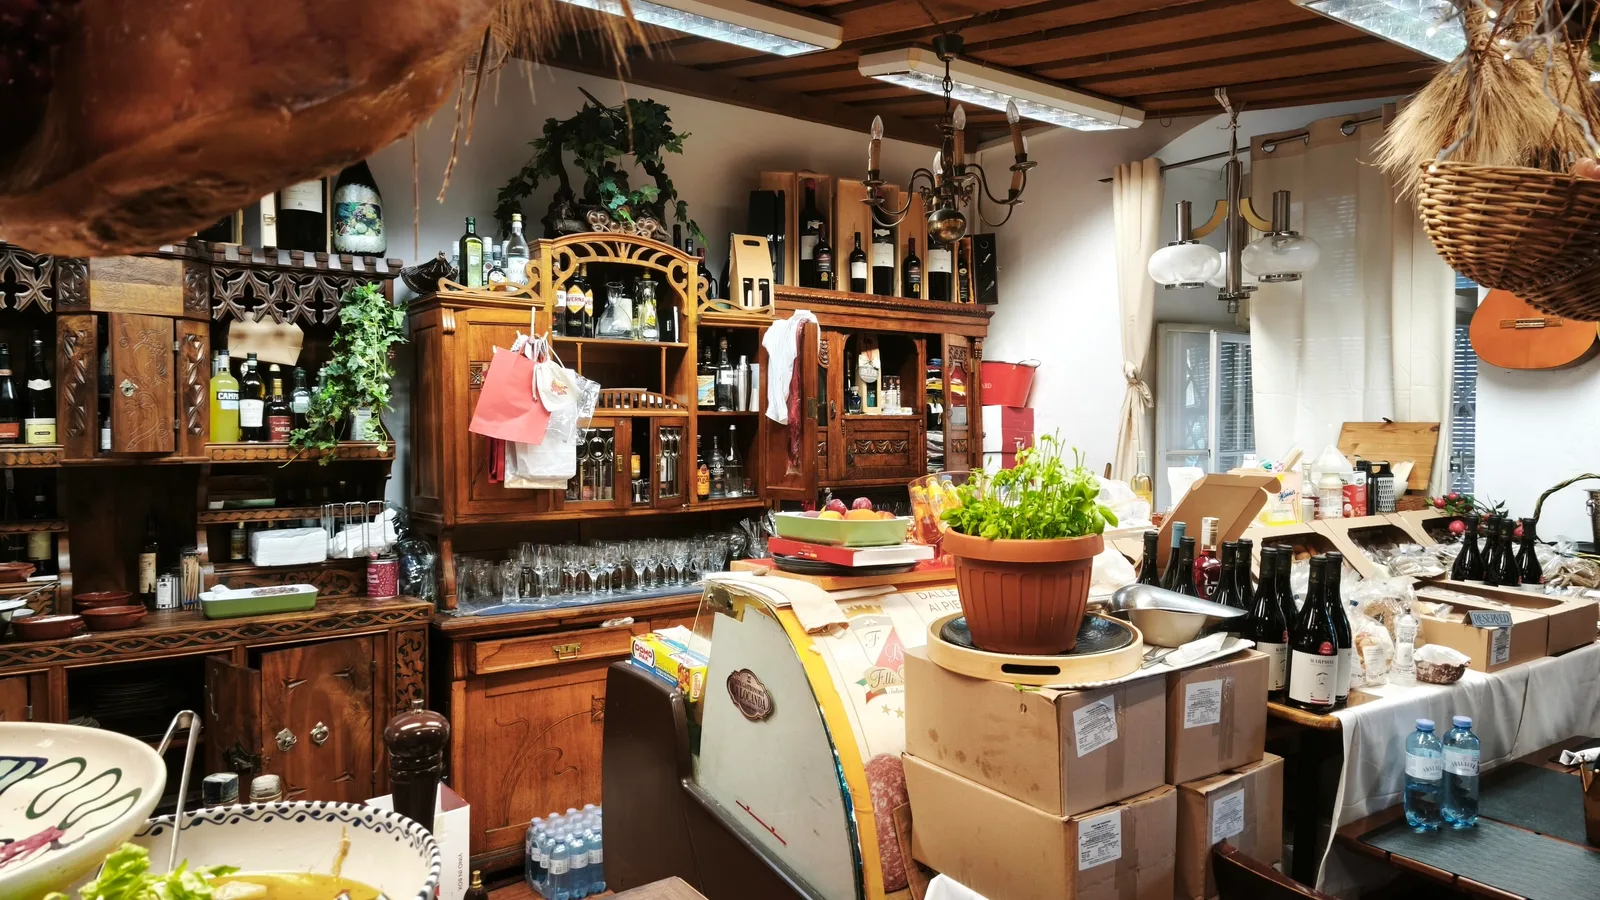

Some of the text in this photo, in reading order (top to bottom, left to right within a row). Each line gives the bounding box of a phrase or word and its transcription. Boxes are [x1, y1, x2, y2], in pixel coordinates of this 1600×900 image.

[916, 589, 957, 600] DALLE
[1473, 613, 1510, 625] RESERVED
[634, 644, 653, 658] DOMO
[638, 652, 649, 661] PAK
[739, 686, 766, 710] LOCANDA
